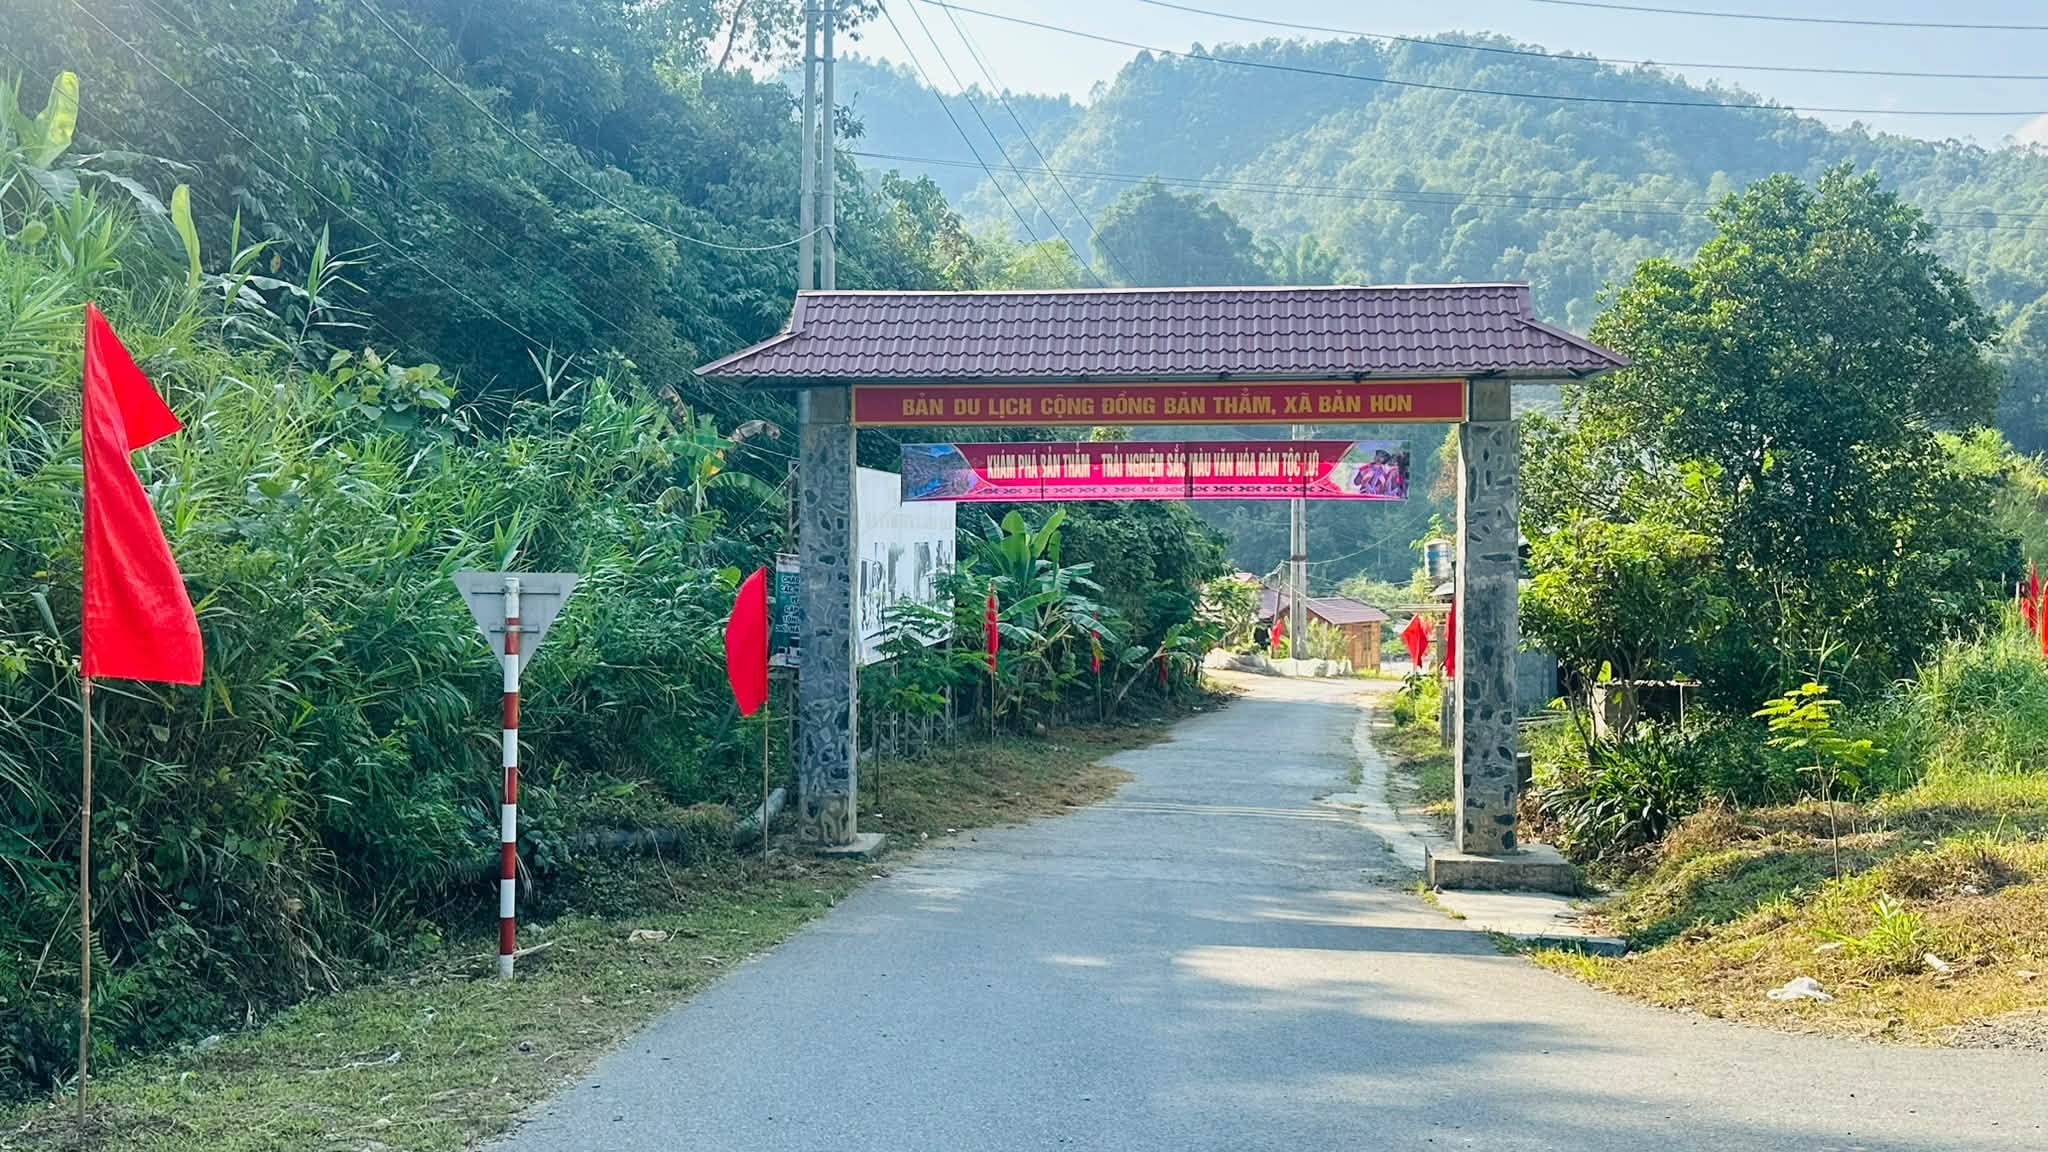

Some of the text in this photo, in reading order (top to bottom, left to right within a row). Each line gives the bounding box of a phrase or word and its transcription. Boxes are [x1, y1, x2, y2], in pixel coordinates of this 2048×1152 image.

[902, 392, 944, 416] BẢN
[953, 398, 981, 416] DU
[988, 397, 1032, 419] LỊCH
[1040, 393, 1095, 419] CỘNG
[1101, 390, 1156, 416] ĐỒNG
[1164, 391, 1205, 415] BẢN
[1283, 392, 1313, 413] XÃ
[1318, 388, 1361, 413] BẢN
[1369, 394, 1412, 413] HON
[986, 448, 1016, 479] KHÁM
[1017, 448, 1039, 479] PHÁ
[1101, 444, 1123, 478] TRẢI
[1125, 447, 1164, 483] NGHIỆM
[1166, 443, 1186, 477] SẮC
[1214, 447, 1234, 477] VĂN
[1235, 447, 1256, 477] HÓA
[1258, 447, 1280, 477] DÂN
[1281, 447, 1301, 483] TỘC
